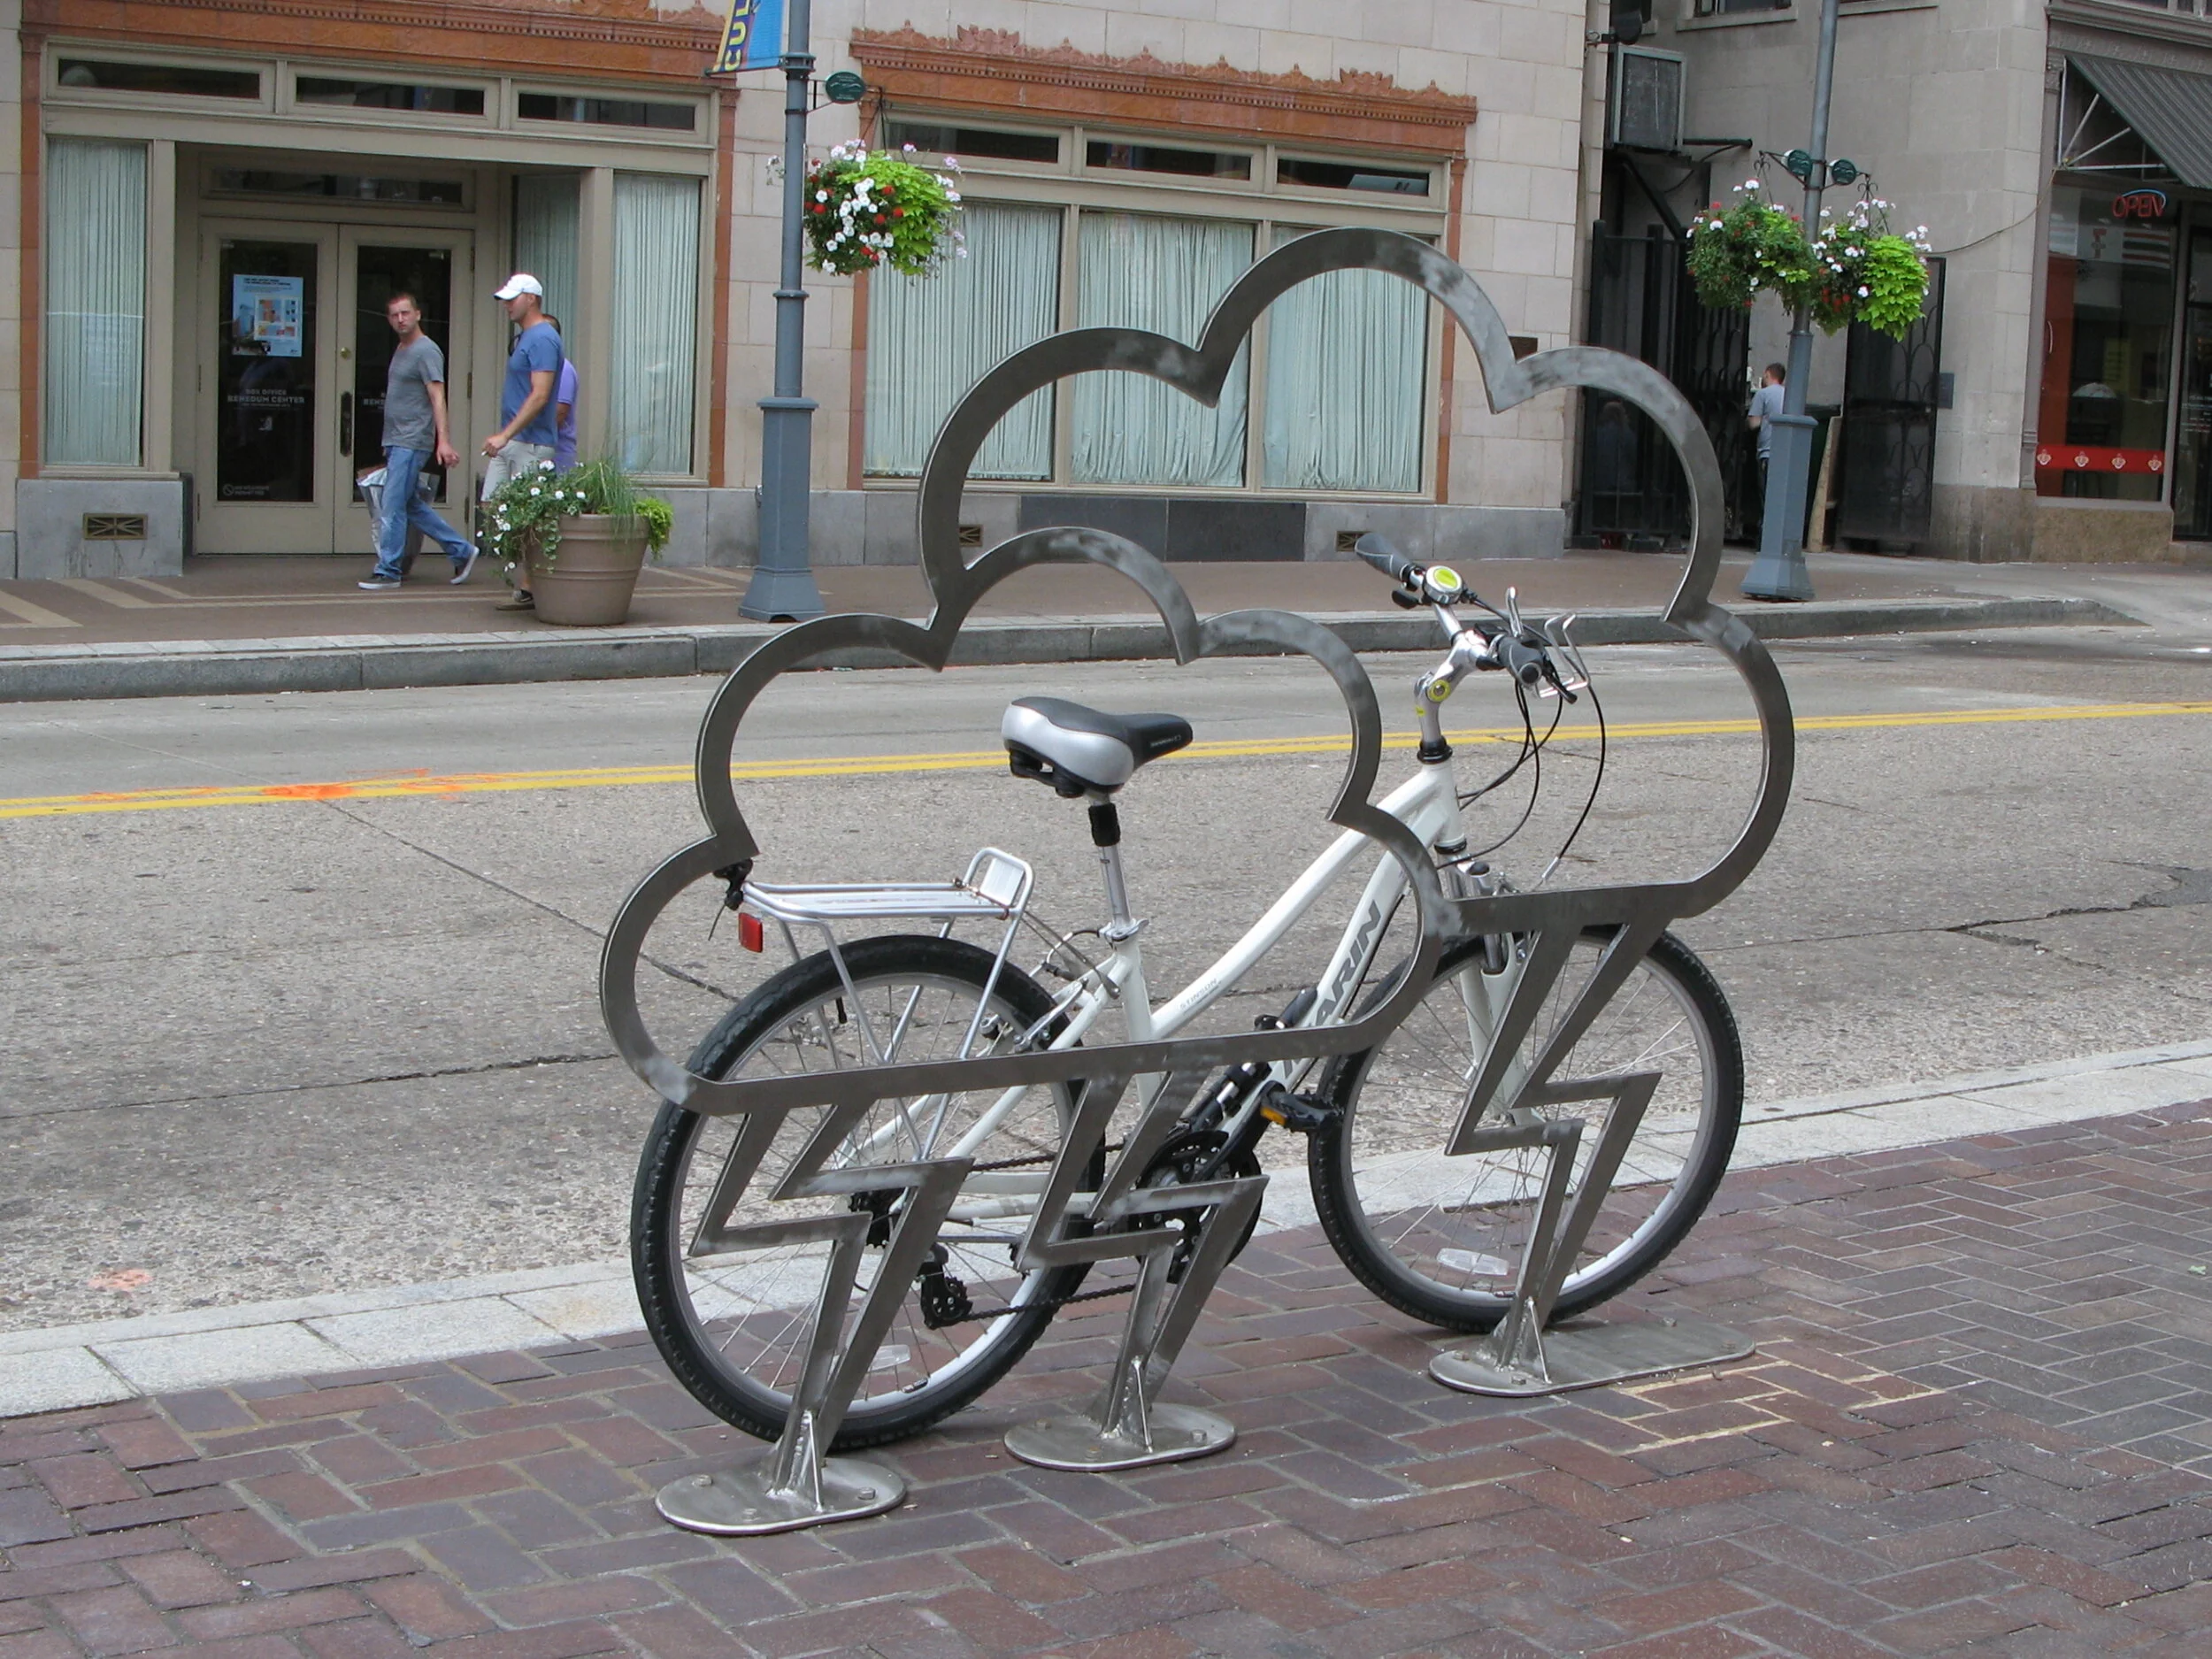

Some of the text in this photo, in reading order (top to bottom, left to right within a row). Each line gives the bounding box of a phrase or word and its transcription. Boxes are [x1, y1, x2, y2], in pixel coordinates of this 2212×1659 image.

[2112, 194, 2164, 219] OPEN
[227, 395, 306, 404] BENEDUM CENTER
[1179, 978, 1217, 1009] STINSON
